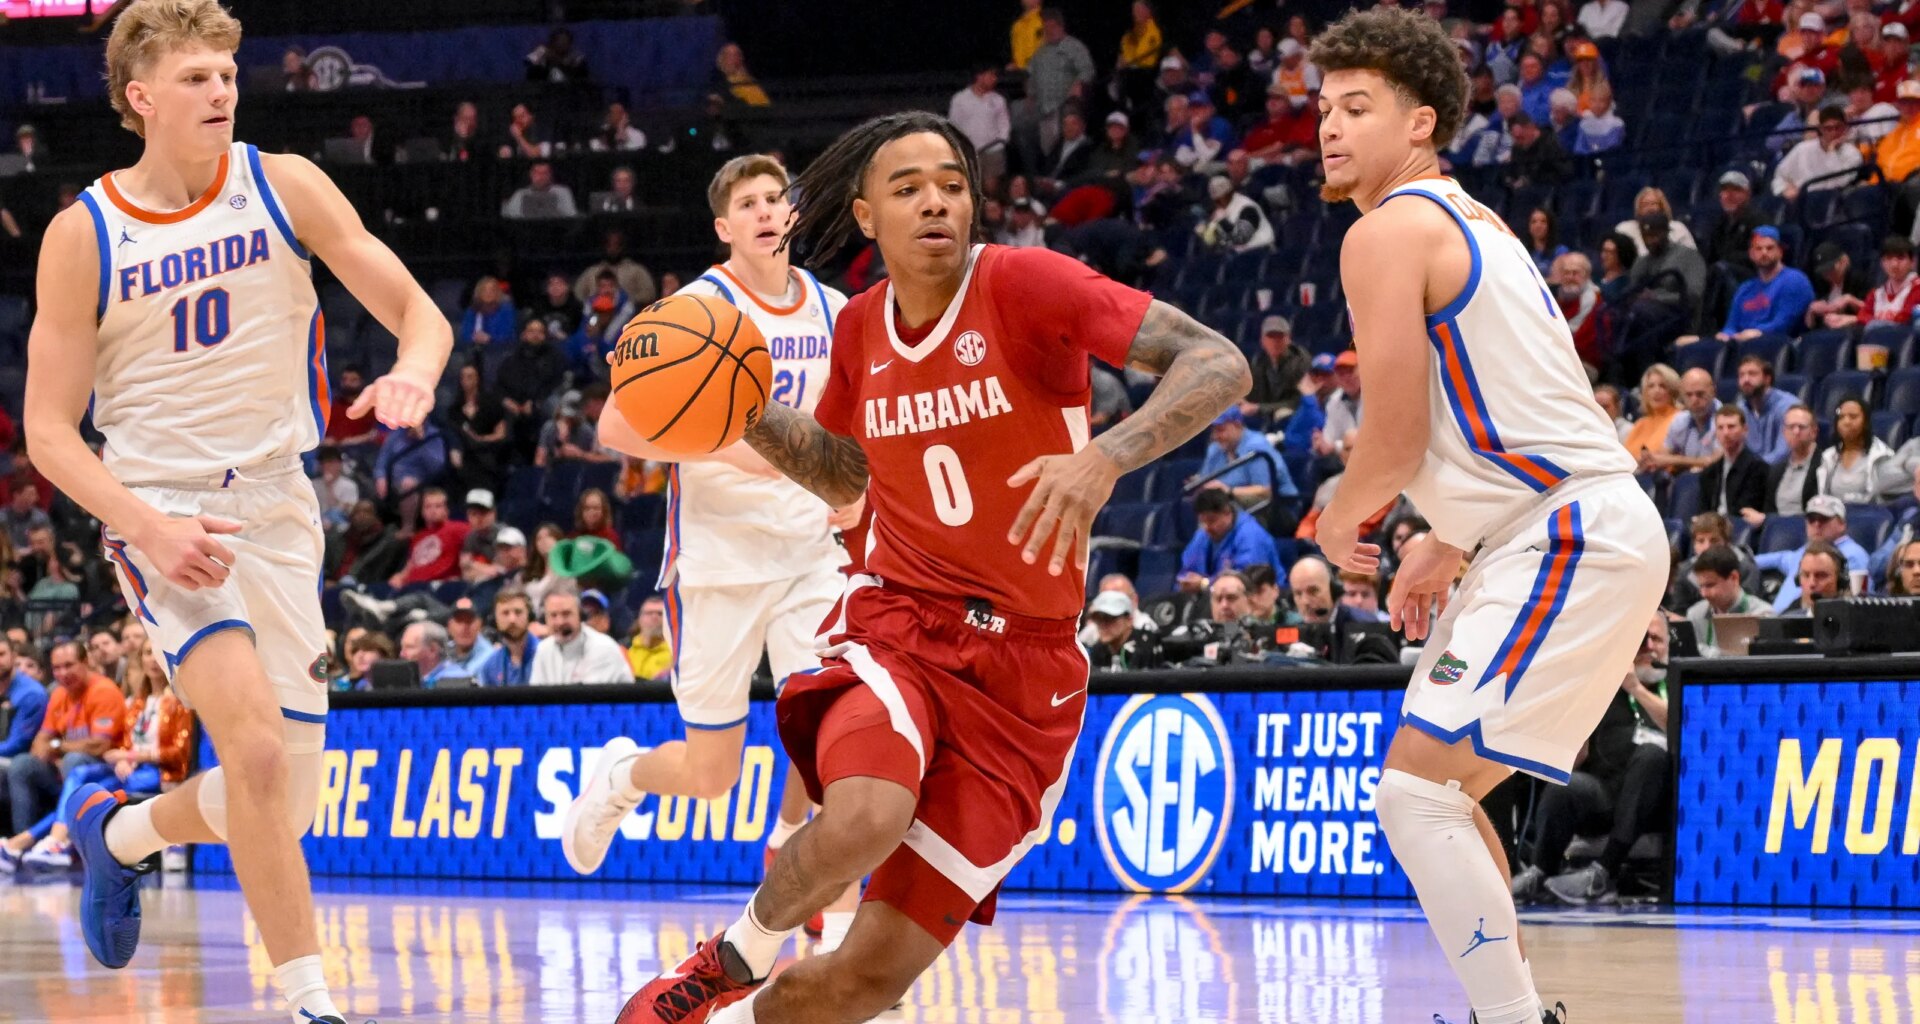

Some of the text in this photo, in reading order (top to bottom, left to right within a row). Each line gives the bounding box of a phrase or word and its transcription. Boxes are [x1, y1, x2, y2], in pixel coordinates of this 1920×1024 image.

[118, 228, 270, 303] FLORIDA
[171, 286, 230, 353] 10
[771, 335, 828, 360] ORIDA
[955, 331, 985, 365] SEC
[772, 367, 806, 409] 21
[865, 376, 1013, 438] ALABAMA
[923, 444, 974, 527] 0
[1256, 712, 1383, 757] IT JUST
[312, 749, 379, 838] RE
[390, 747, 523, 839] LAST
[1111, 707, 1217, 877] SEC
[1253, 766, 1380, 811] MEANS
[1250, 820, 1384, 875] MORE.
